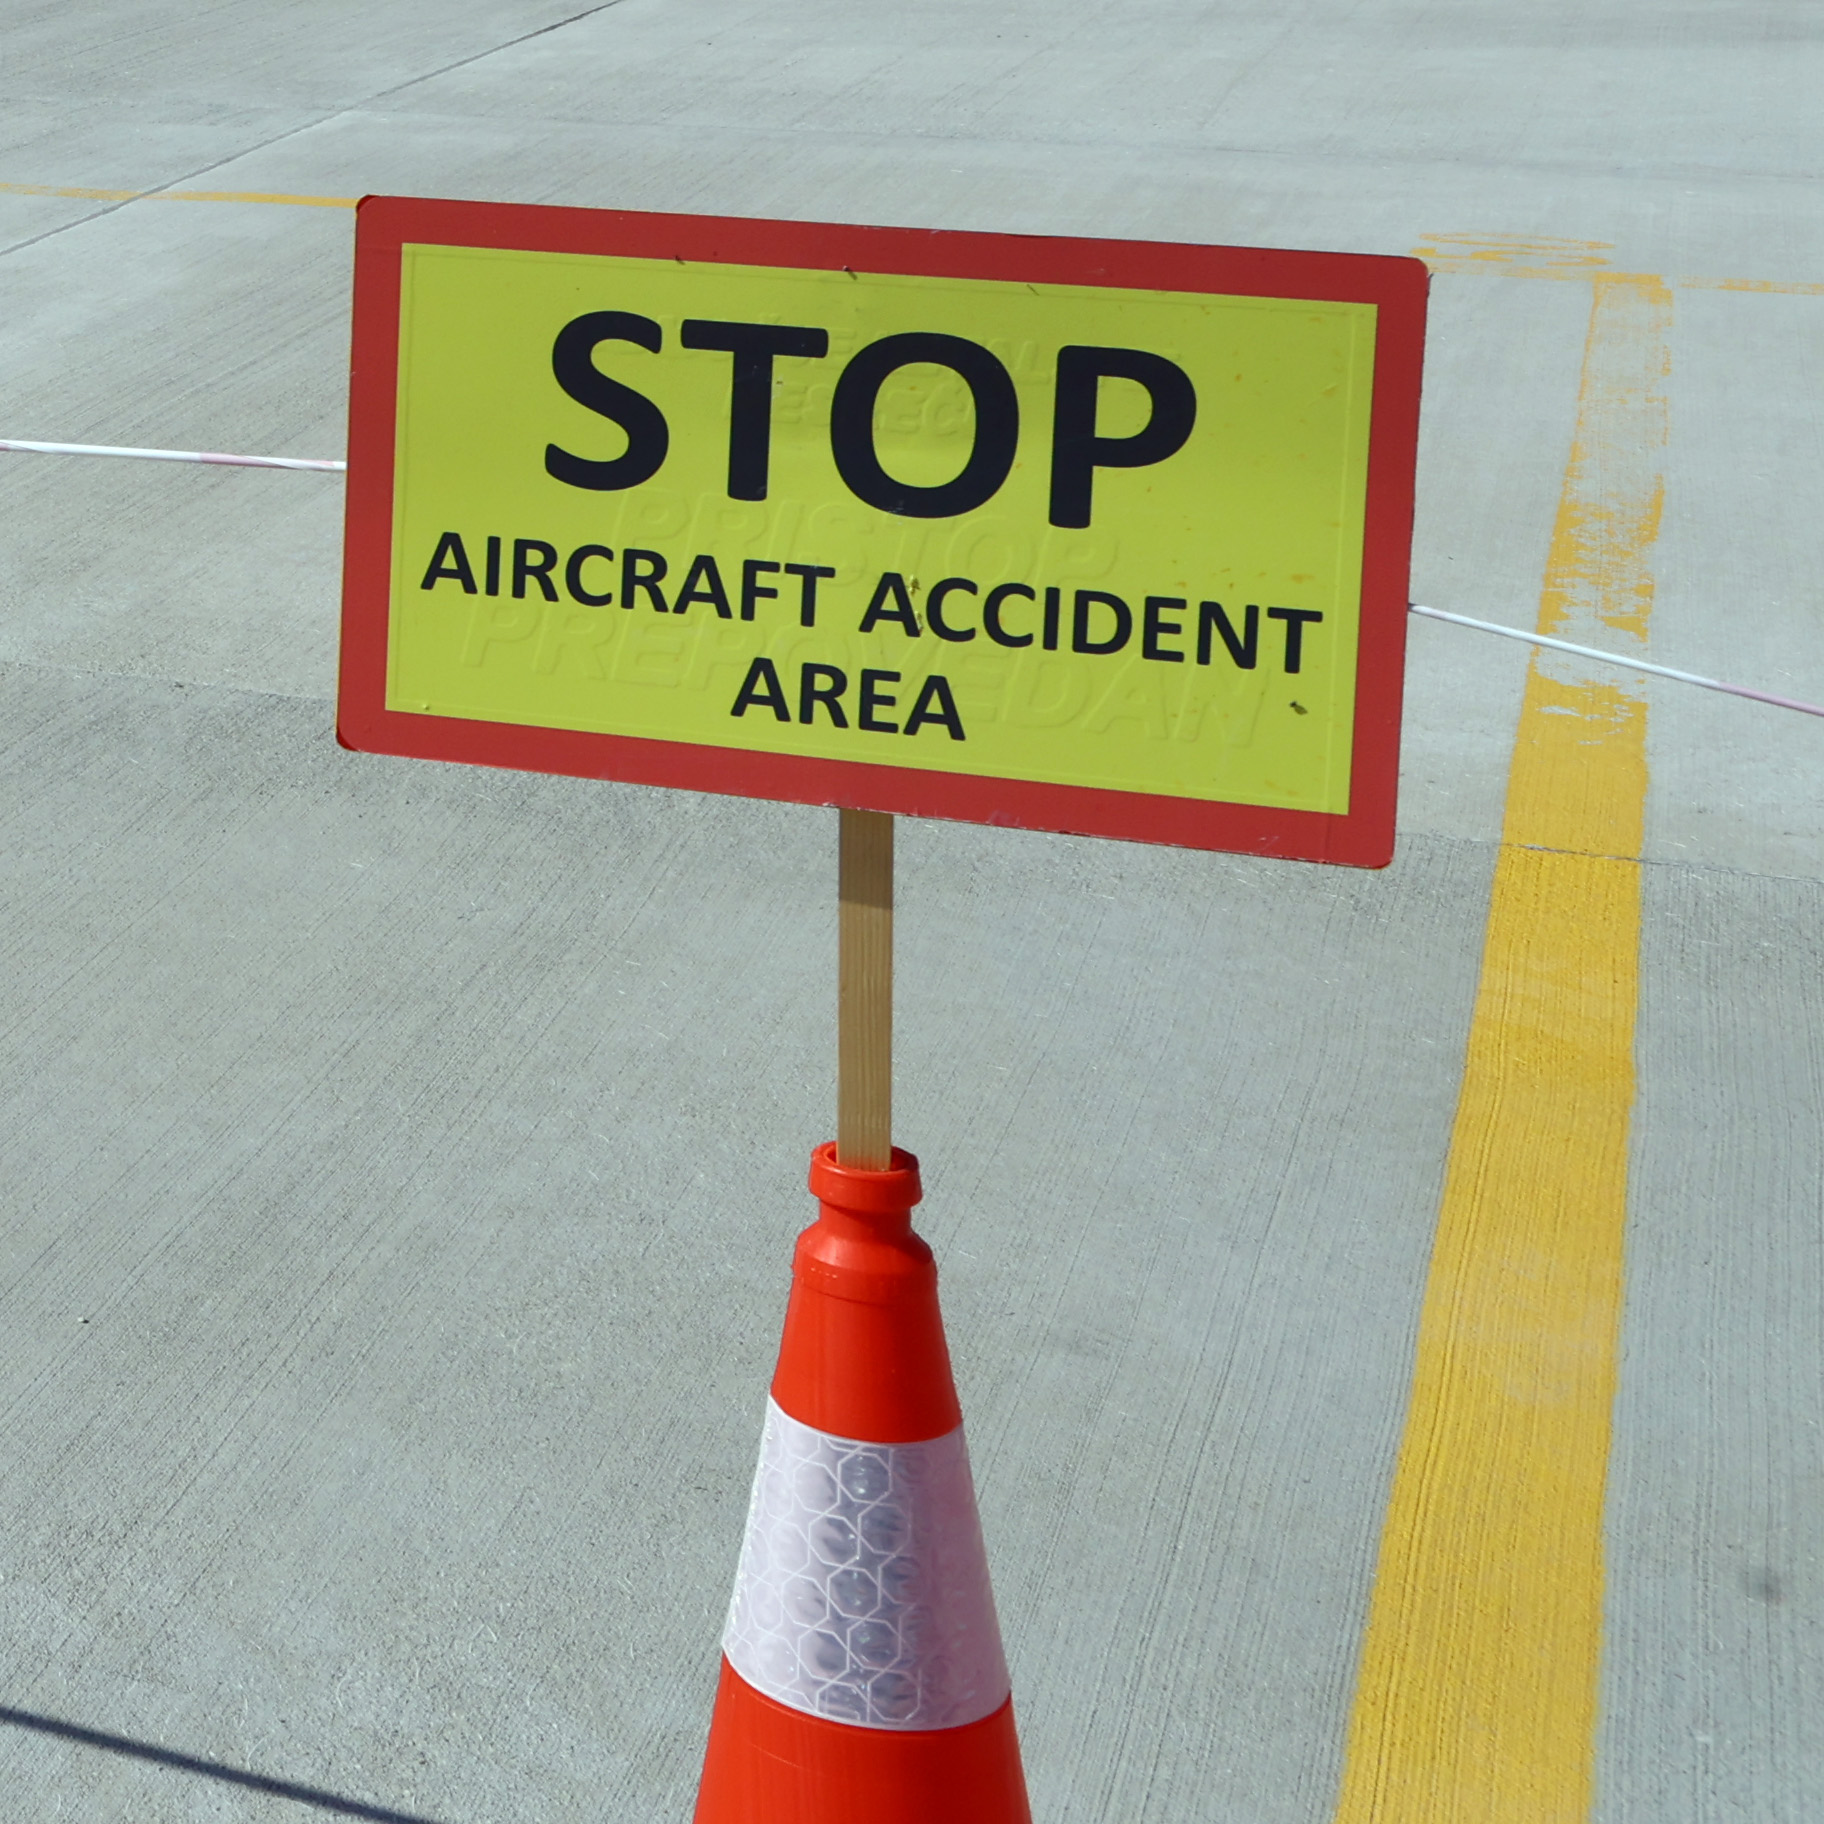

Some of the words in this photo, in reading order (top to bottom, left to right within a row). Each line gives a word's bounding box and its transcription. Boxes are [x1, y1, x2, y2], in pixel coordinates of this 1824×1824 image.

[544, 310, 1197, 530] STOP
[420, 531, 836, 628] AIRCRAFT
[858, 572, 1323, 674] ACCIDENT
[730, 657, 966, 742] AREA
